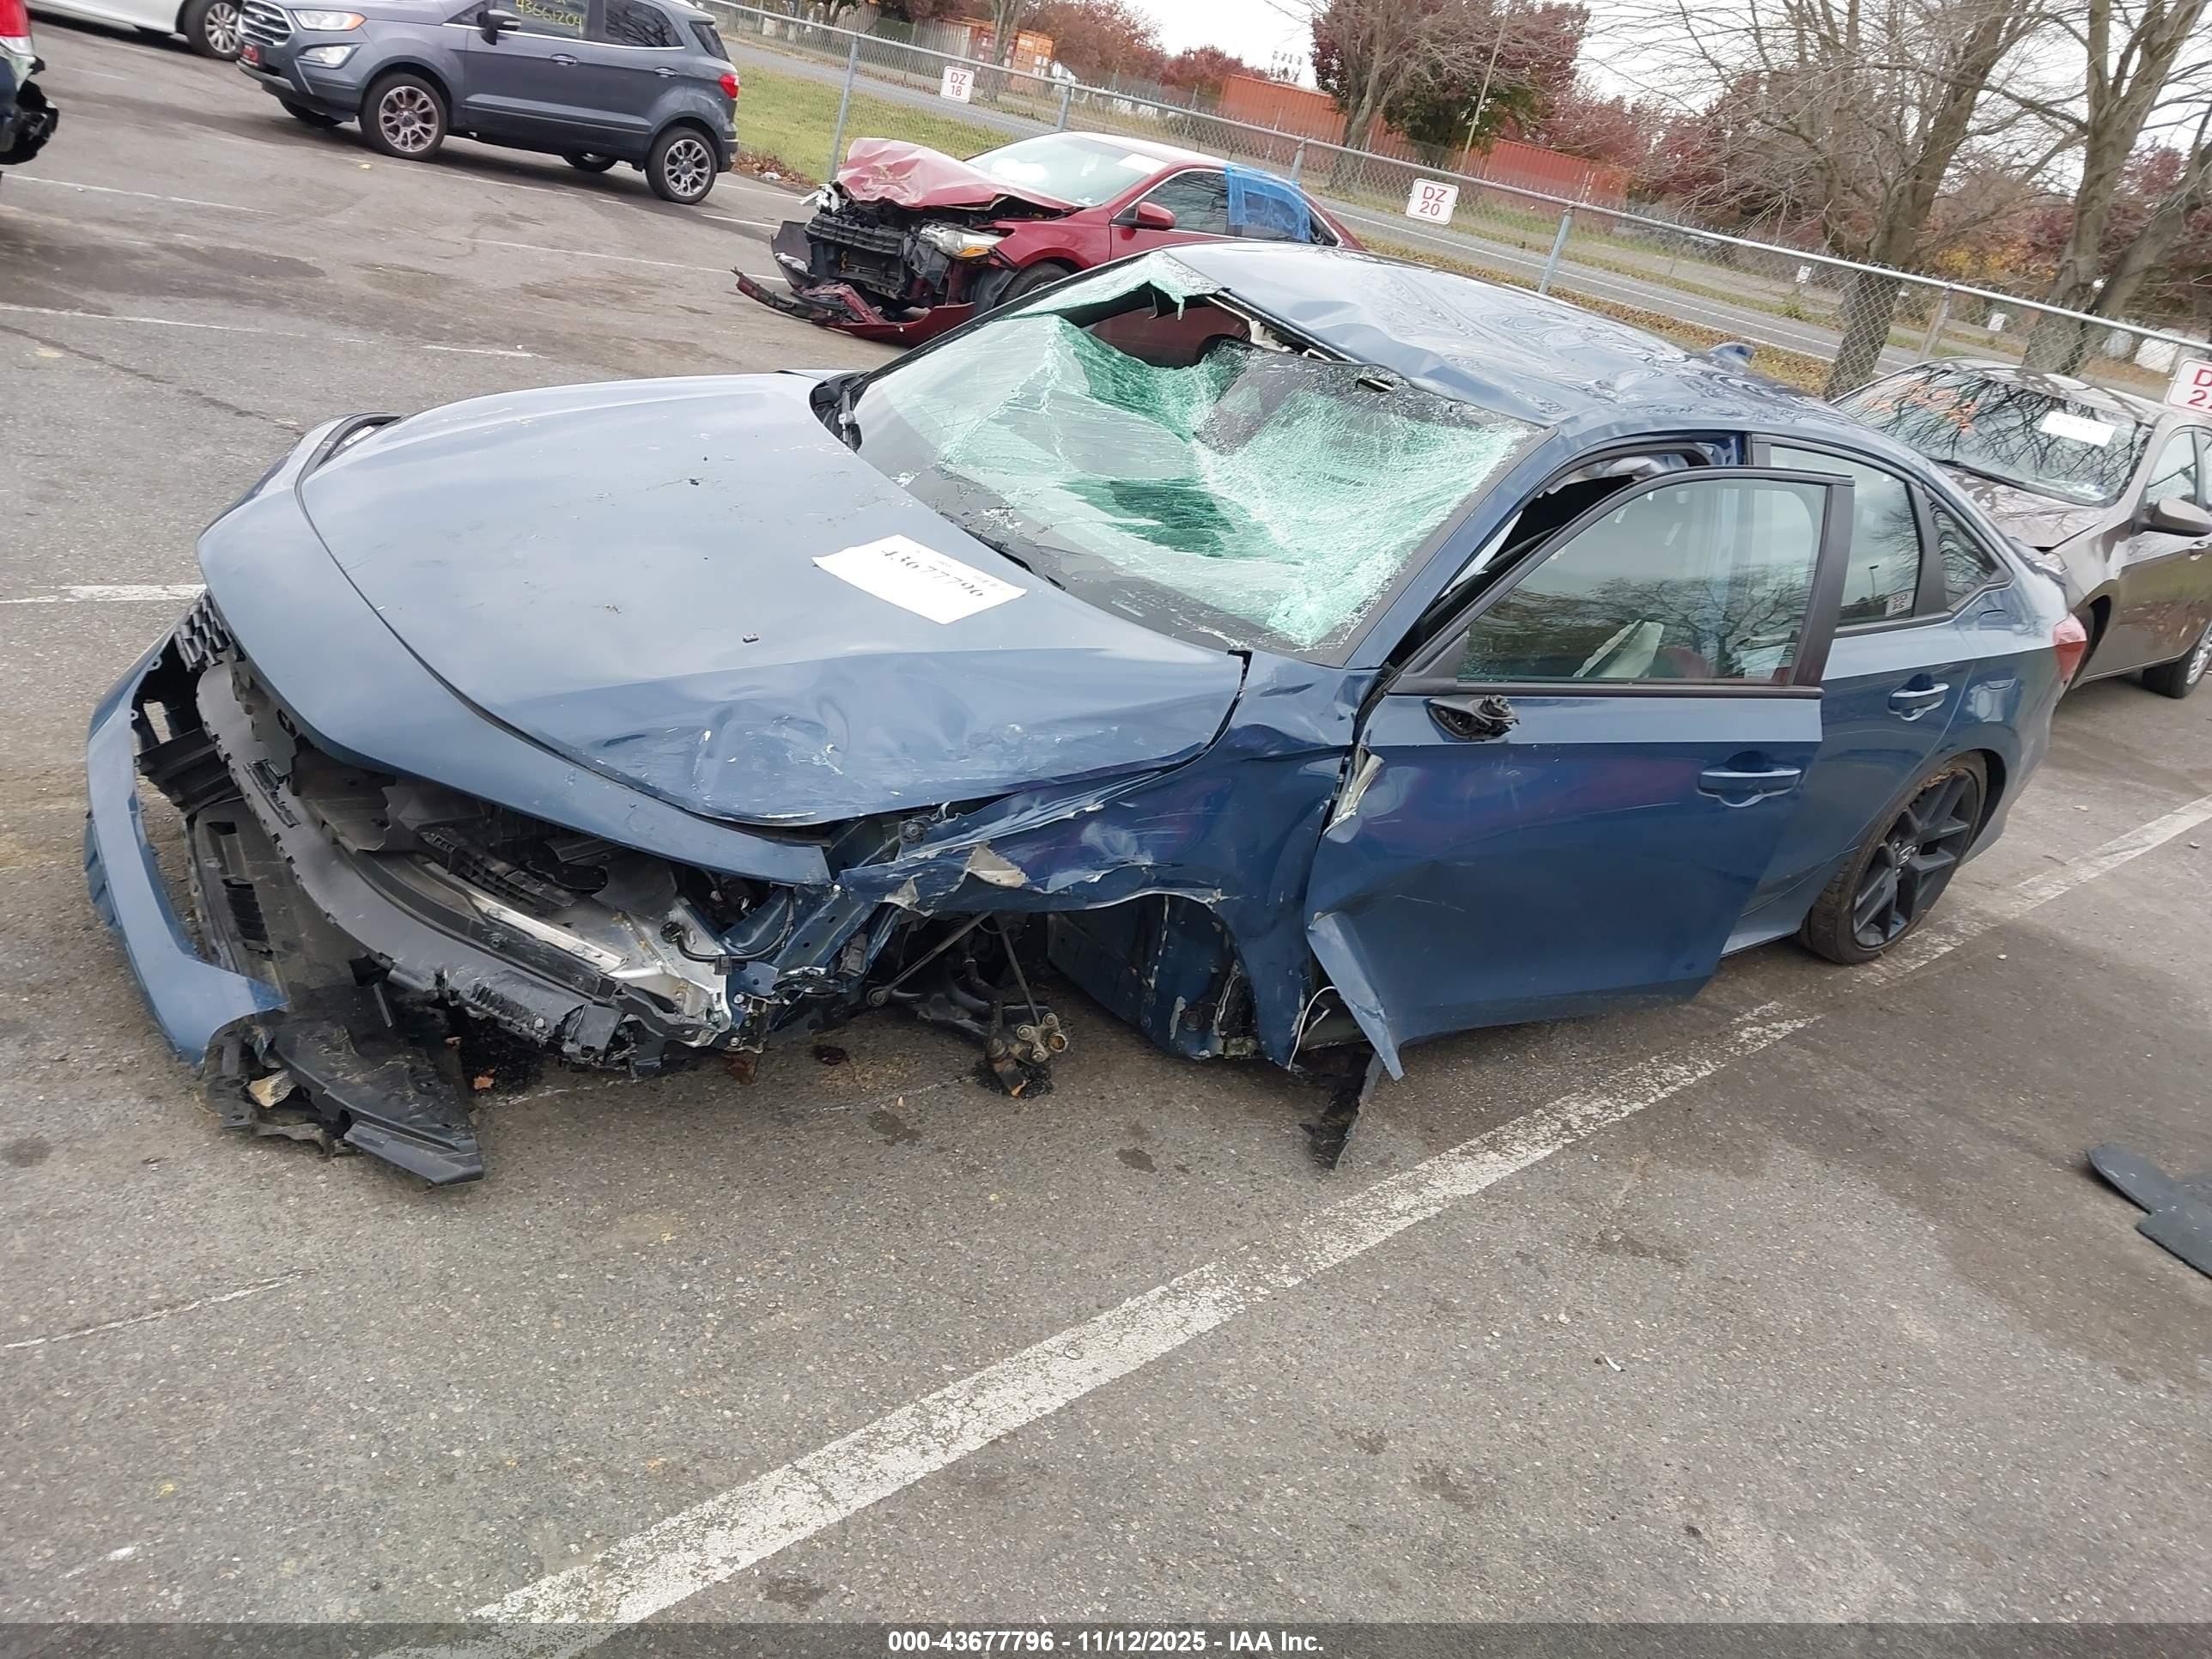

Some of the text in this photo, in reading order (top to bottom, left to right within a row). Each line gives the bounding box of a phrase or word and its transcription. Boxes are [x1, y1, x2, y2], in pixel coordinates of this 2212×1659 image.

[951, 72, 967, 85] DZ
[951, 85, 963, 96] 18
[1423, 185, 1448, 203] DZ
[1419, 201, 1440, 216] 20
[2193, 369, 2212, 386] D
[2187, 389, 2212, 409] 2
